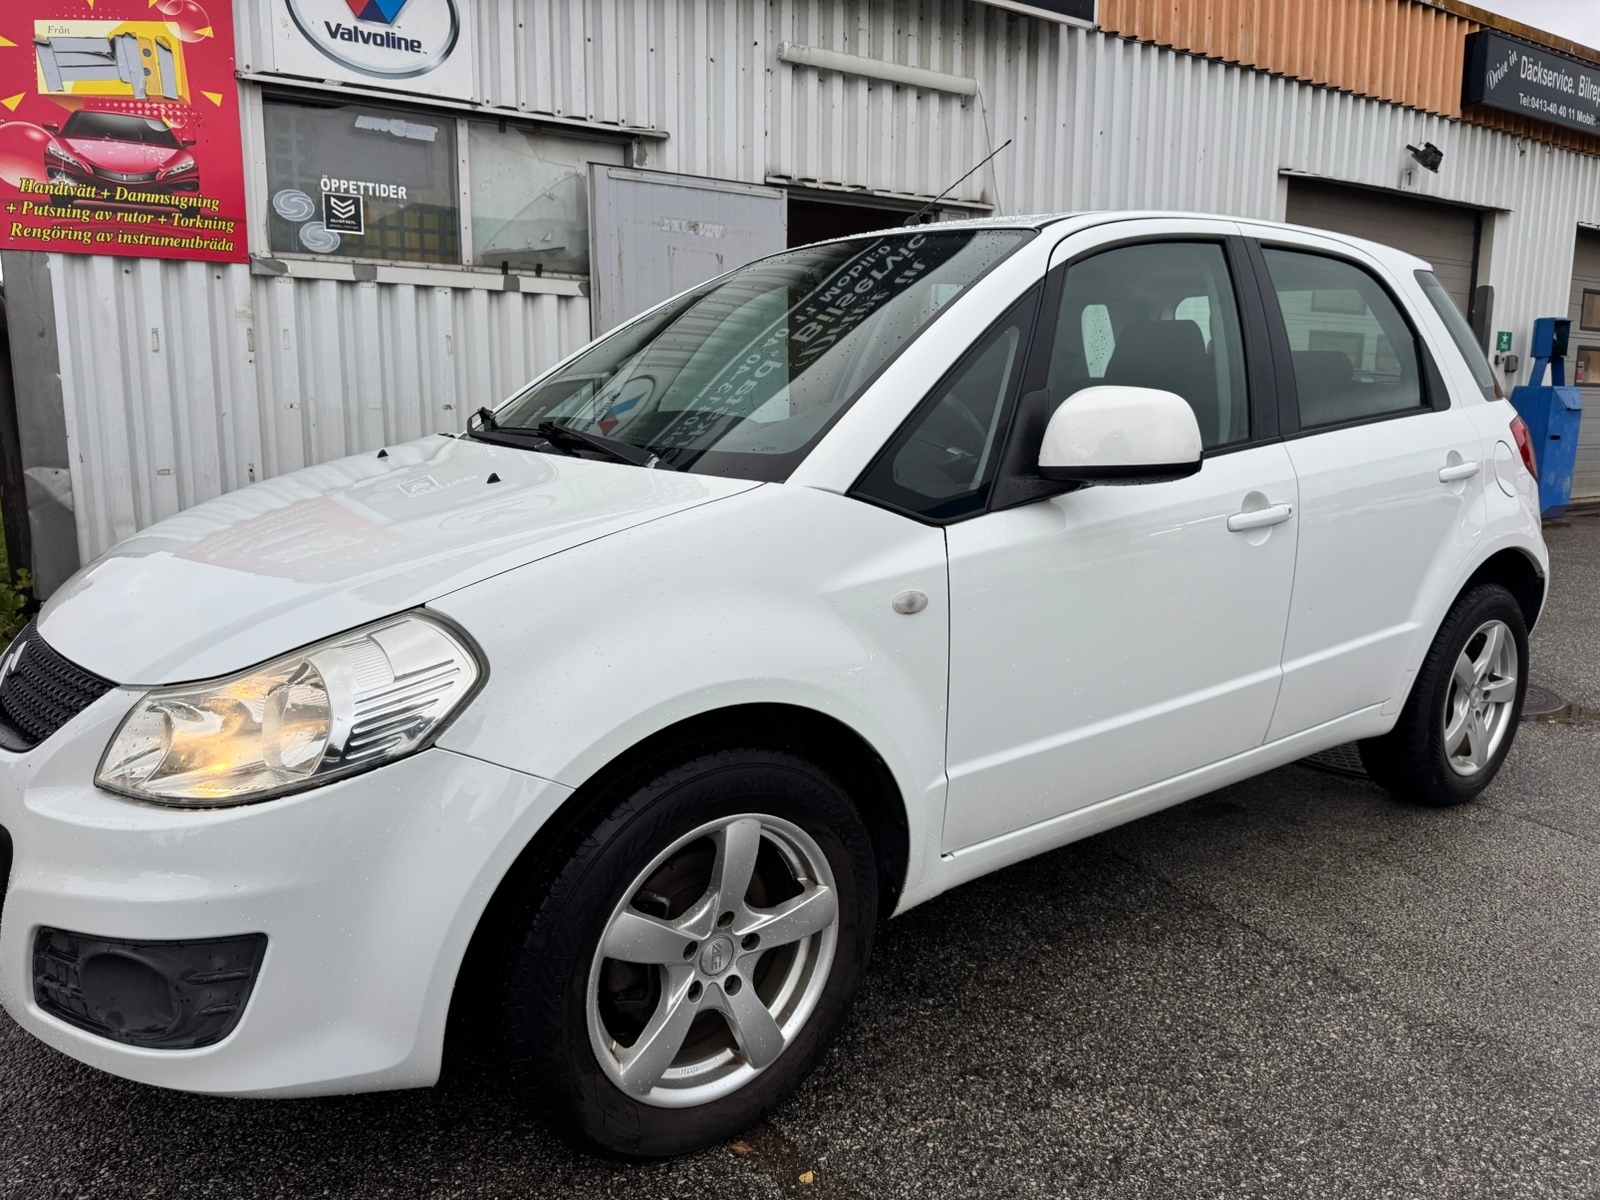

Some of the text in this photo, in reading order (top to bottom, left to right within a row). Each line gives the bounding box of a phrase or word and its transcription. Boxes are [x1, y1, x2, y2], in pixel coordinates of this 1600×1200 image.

[47, 25, 70, 34] Från
[324, 21, 422, 53] Valvoline
[1486, 50, 1517, 90] Drive in
[1520, 55, 1575, 94] Däckservice.
[1558, 105, 1567, 118] 40
[1568, 108, 1575, 120] 11
[320, 174, 407, 199] ÖPPETTIDER
[1407, 171, 1412, 186] 1
[20, 178, 220, 212] Handtvätt + Dammsugning
[6, 201, 235, 234] + Putsning av rutor + Torkning
[10, 222, 234, 252] Rengöring av instrumentbräda
